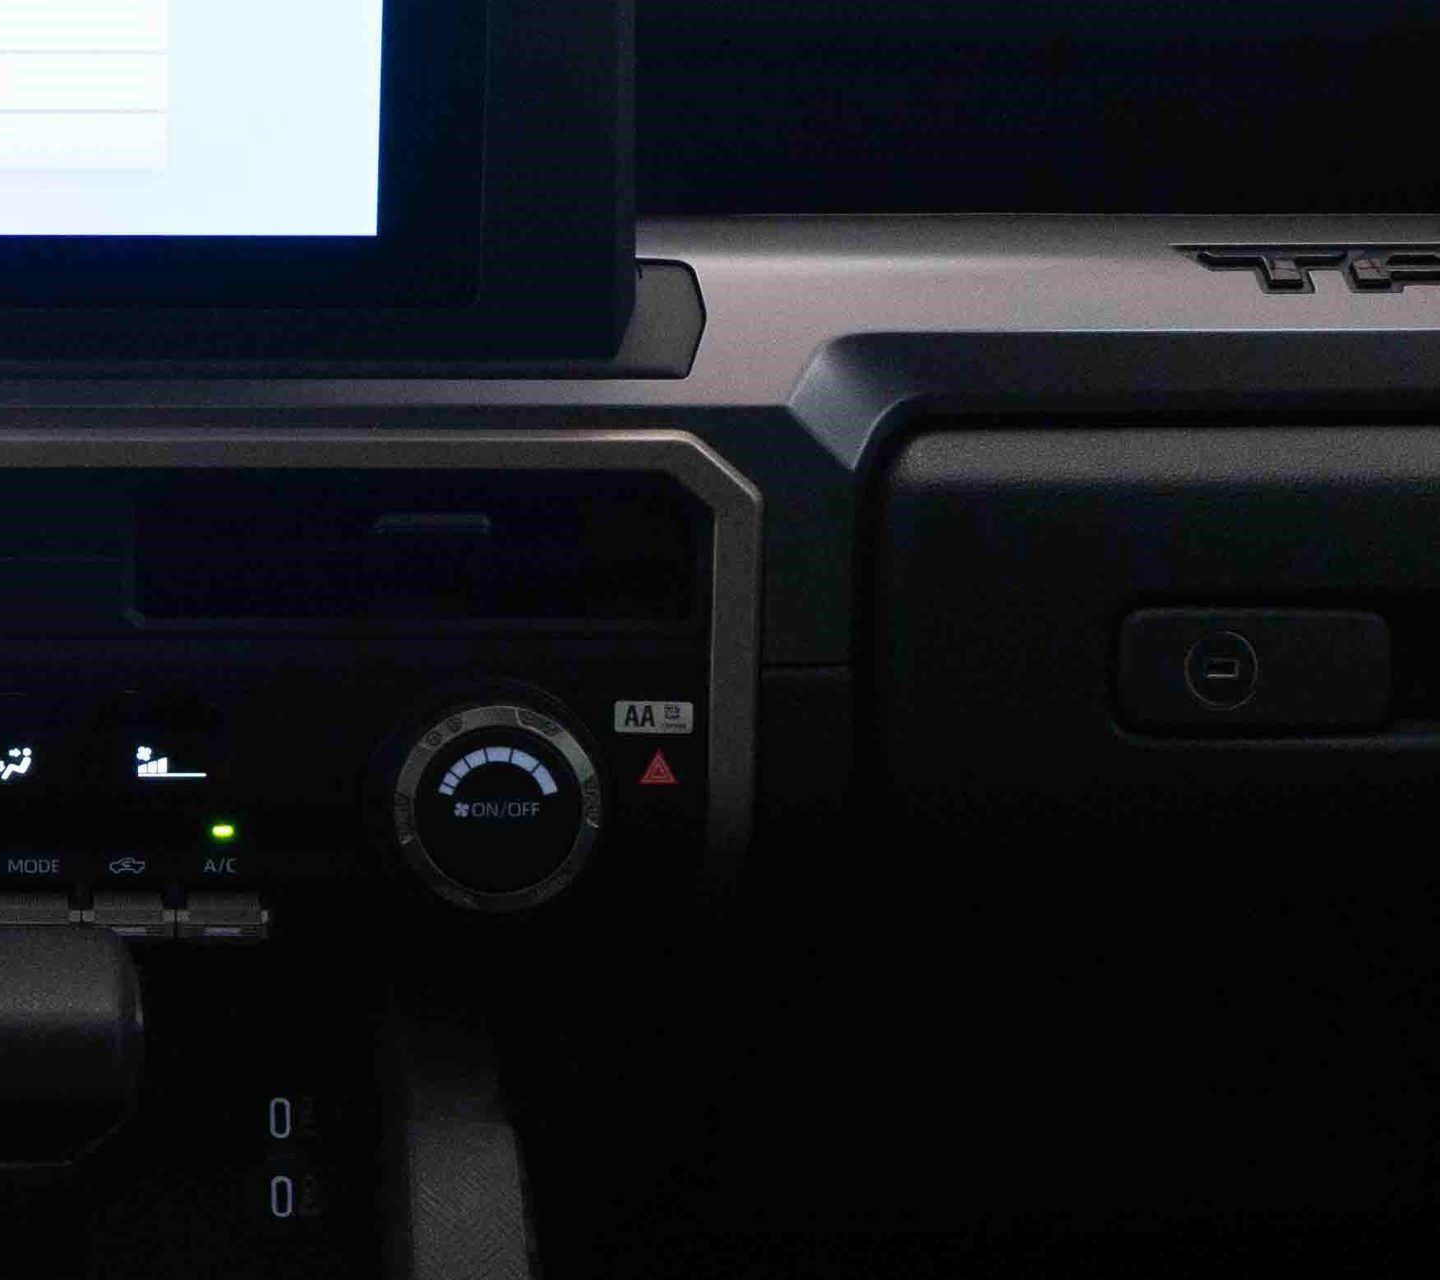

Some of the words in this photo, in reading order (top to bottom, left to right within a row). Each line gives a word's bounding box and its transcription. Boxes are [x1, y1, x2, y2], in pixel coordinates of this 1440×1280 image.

[624, 704, 655, 727] AA
[471, 801, 541, 818] ON/OFF
[7, 857, 60, 874] MODE
[204, 857, 237, 874] A/C
